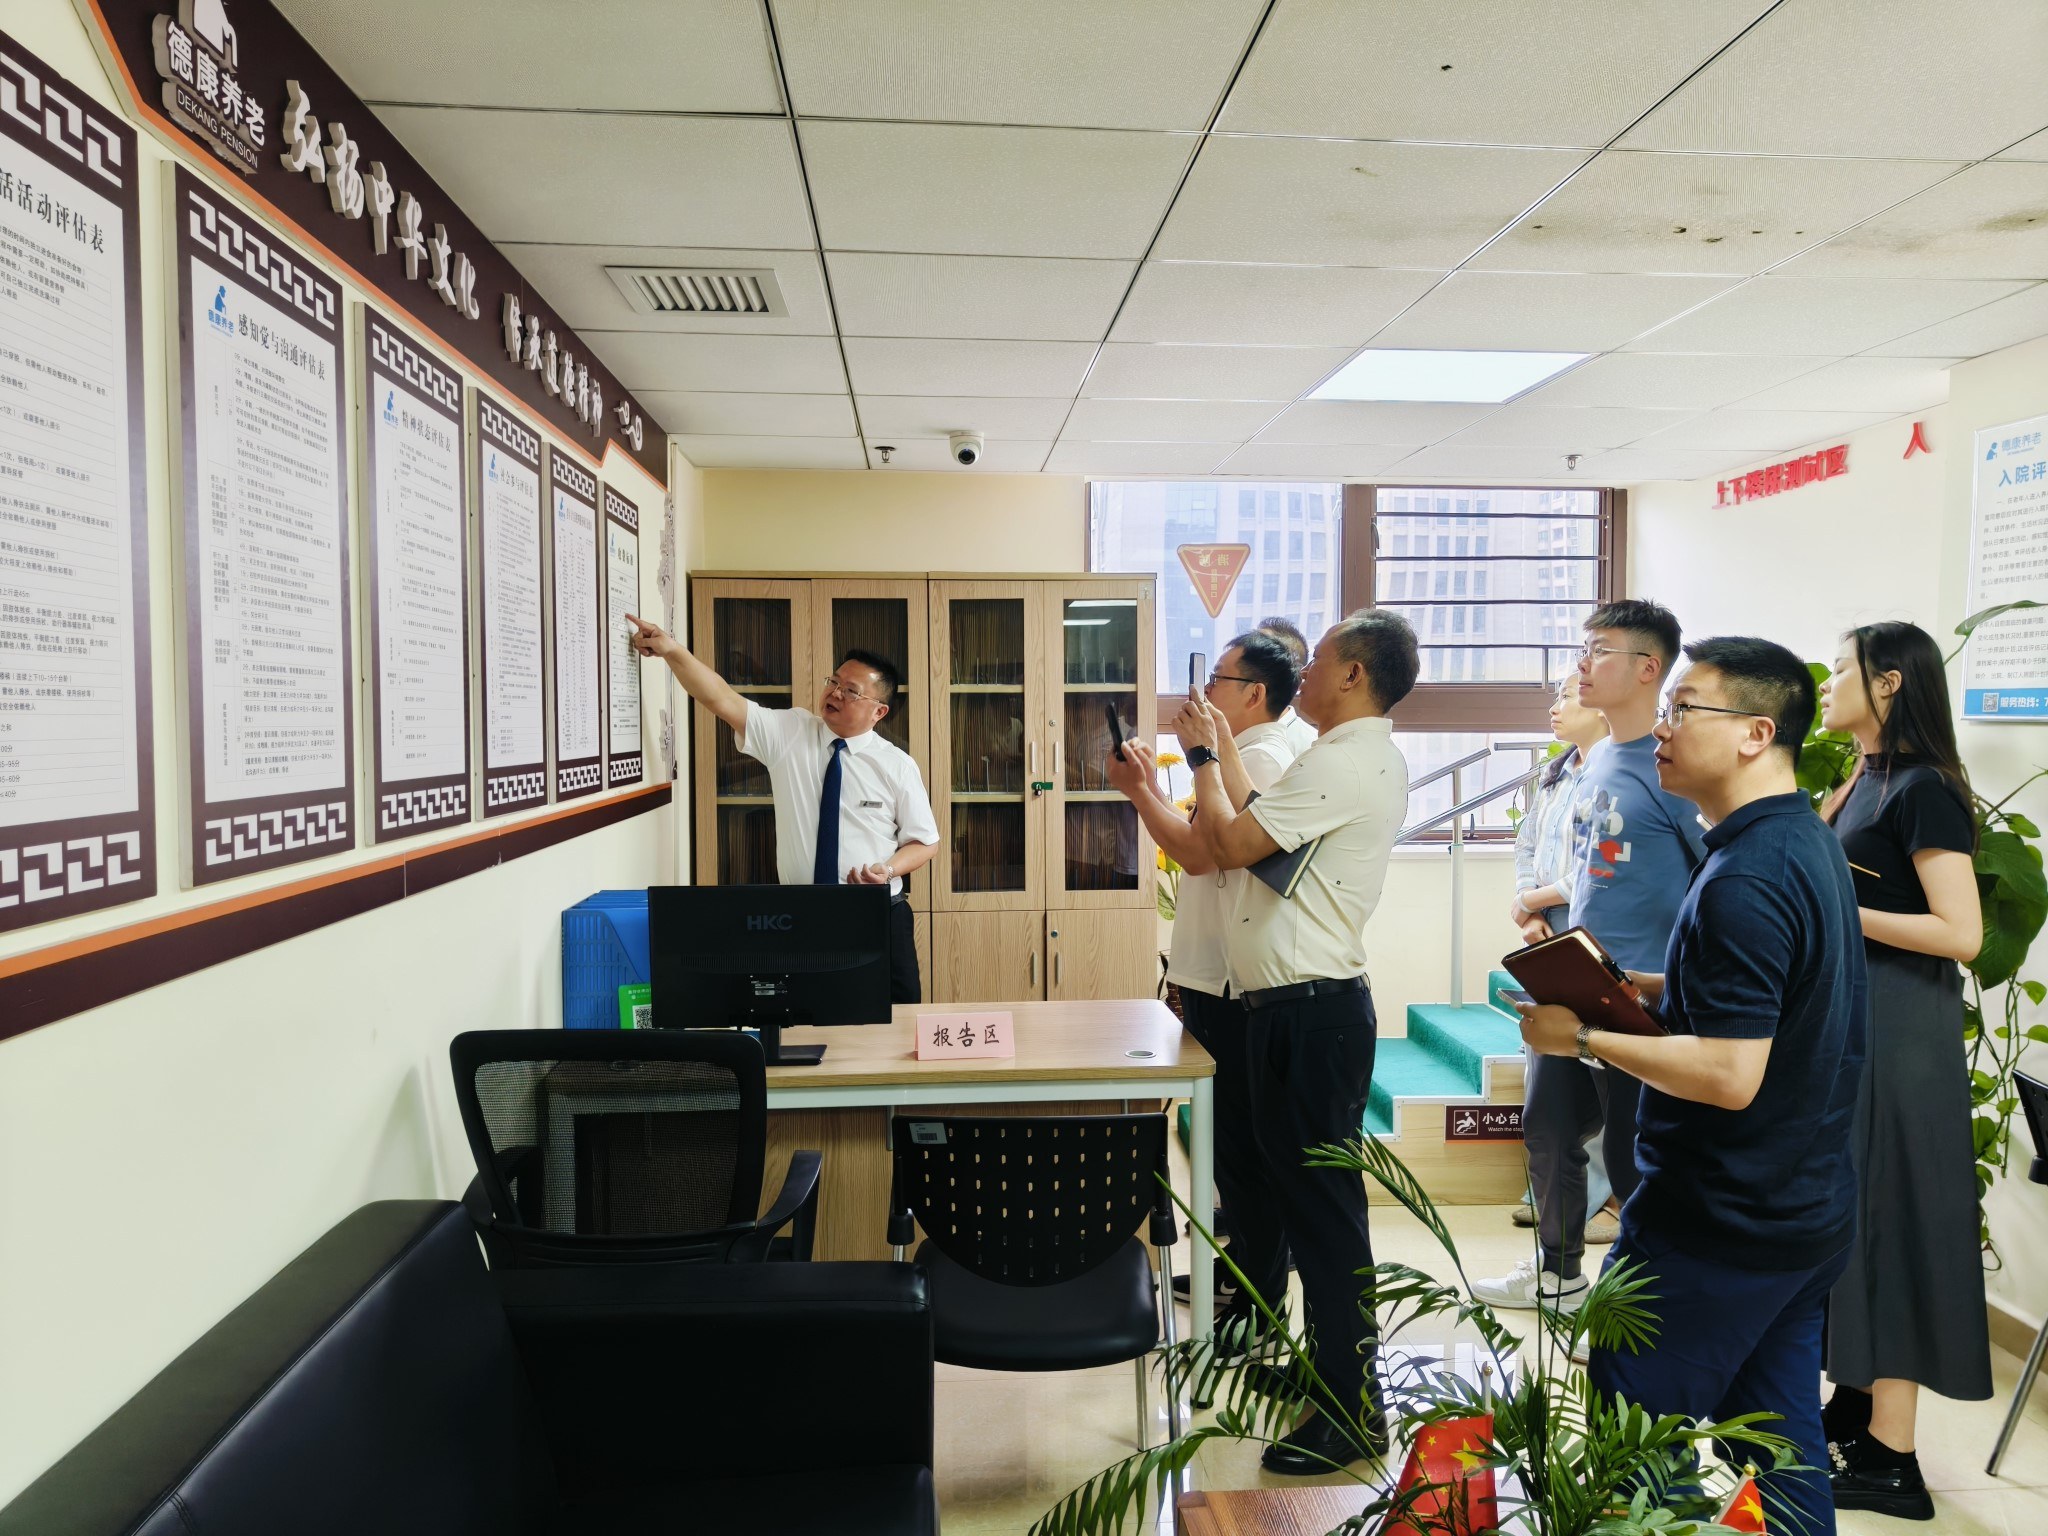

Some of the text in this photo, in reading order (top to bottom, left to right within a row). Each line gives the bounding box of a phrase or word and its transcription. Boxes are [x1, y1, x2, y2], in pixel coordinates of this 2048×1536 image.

[168, 21, 265, 147] 德康养老
[177, 89, 258, 169] DEKANG PENSION
[280, 79, 480, 320] 弘扬中华文化
[238, 313, 326, 381] 感知觉与沟通评估表
[1713, 444, 1851, 510] 上下楼梯测试区
[747, 914, 793, 931] HKC
[933, 1021, 1000, 1047] 报告区
[1482, 1112, 1520, 1125] 小心台
